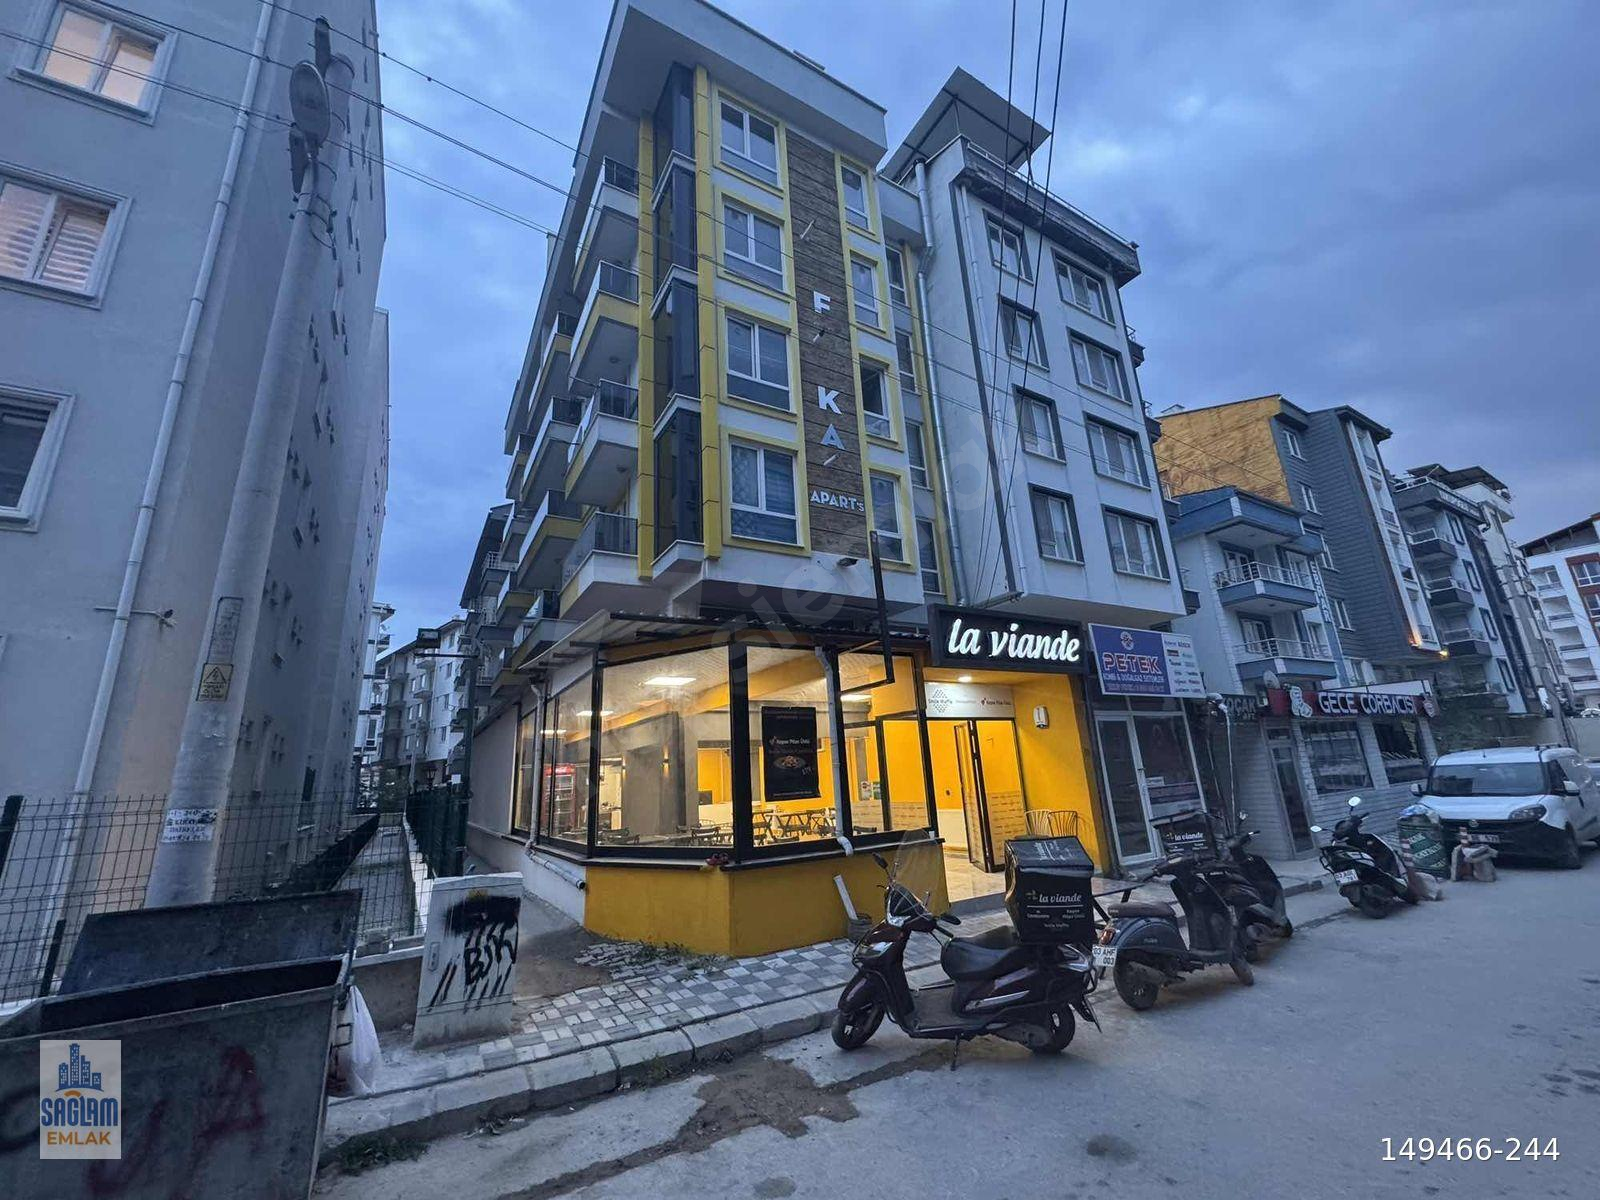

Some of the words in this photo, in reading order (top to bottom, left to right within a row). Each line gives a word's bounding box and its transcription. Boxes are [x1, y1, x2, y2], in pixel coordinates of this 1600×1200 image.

[947, 618, 982, 655] la
[988, 622, 1081, 663] viande
[1102, 652, 1163, 675] PETEK
[1317, 691, 1359, 714] GECE
[1039, 892, 1049, 904] la
[1049, 892, 1082, 904] viande
